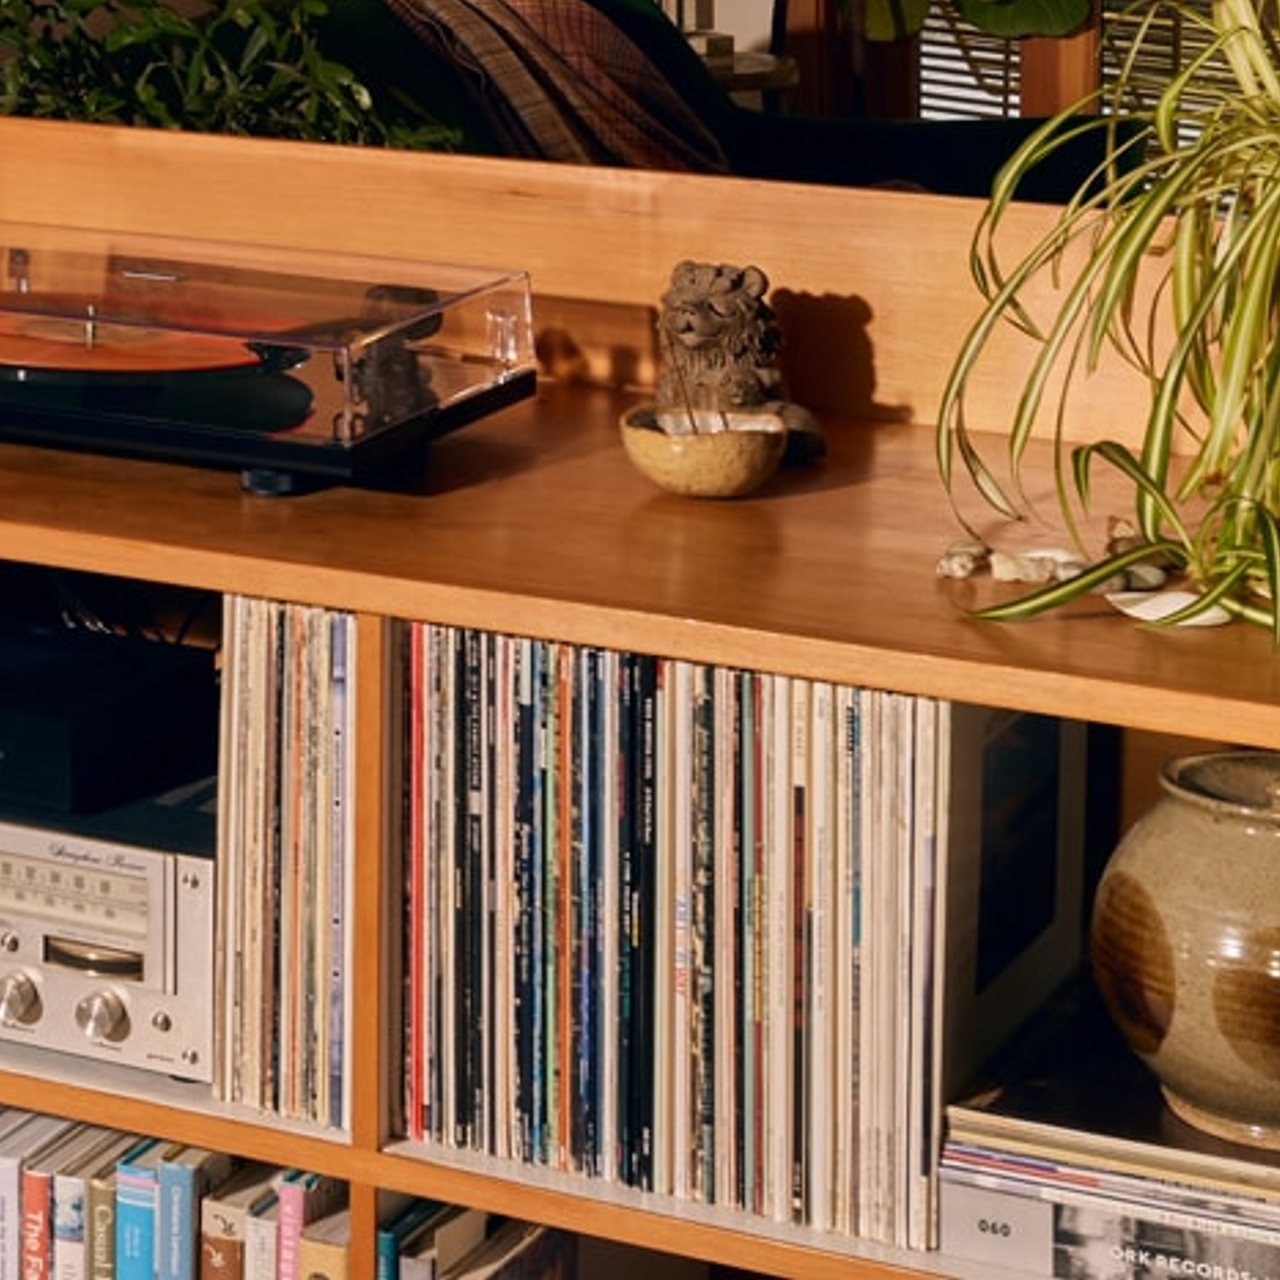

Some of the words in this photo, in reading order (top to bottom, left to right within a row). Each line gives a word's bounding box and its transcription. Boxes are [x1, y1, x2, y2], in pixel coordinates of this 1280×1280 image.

[26, 1210, 44, 1251] The
[93, 1204, 113, 1268] Casual
[281, 1202, 297, 1280] vintag
[976, 1219, 1012, 1238] 060
[1109, 1246, 1151, 1266] ORK
